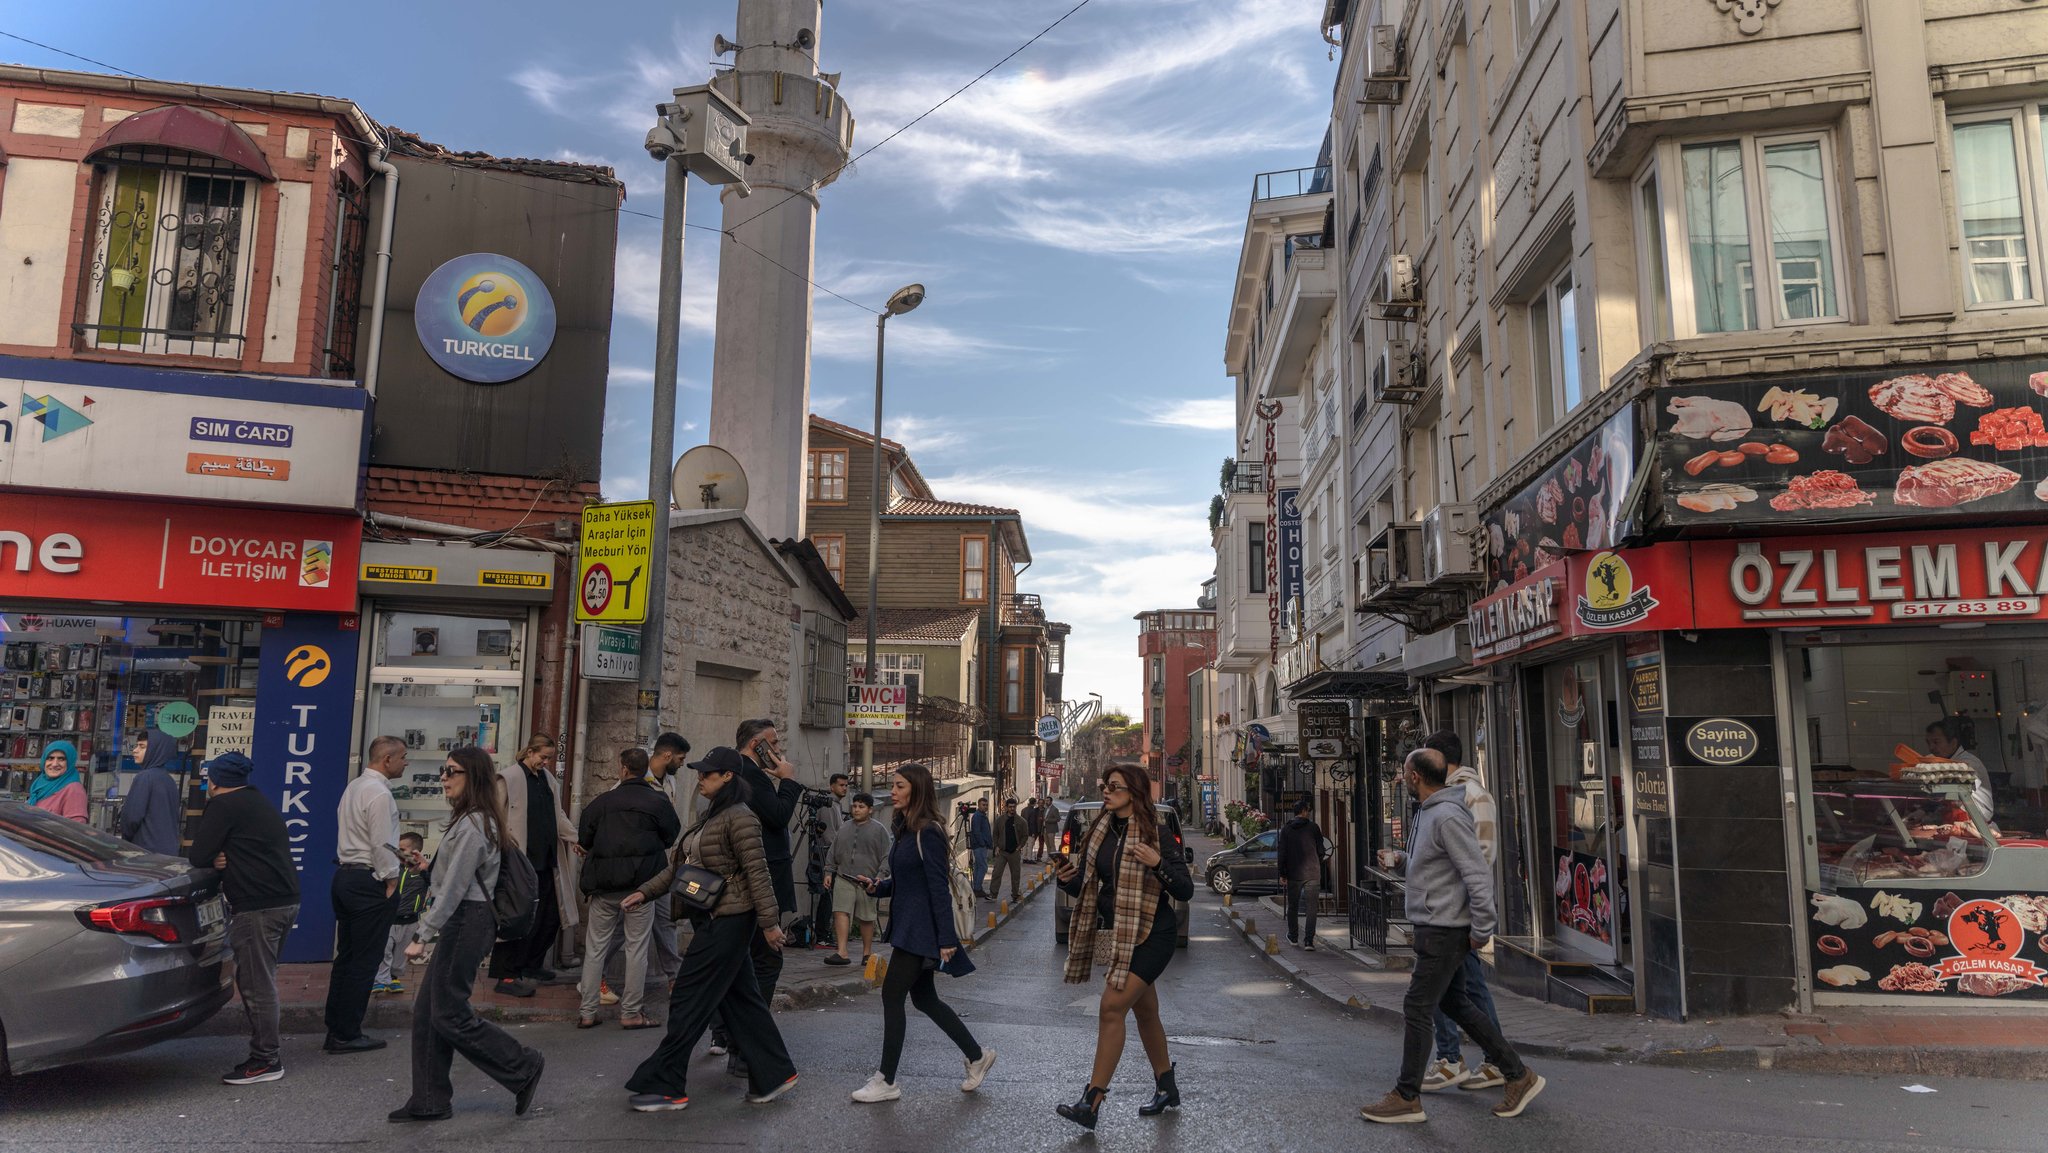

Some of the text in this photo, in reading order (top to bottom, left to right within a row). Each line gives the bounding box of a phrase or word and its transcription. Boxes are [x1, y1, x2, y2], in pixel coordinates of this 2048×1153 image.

[443, 338, 534, 361] TURKCELL
[195, 421, 289, 443] SIM CARD
[201, 457, 276, 476] بطاقة سيم
[587, 508, 651, 523] Daha Yüksek
[588, 524, 646, 541] Araçlar İçin
[189, 535, 297, 560] DOYCAR
[585, 544, 647, 558] Mecburi Yön
[1263, 422, 1279, 665] KUMLUK KONAK HOTEL
[1289, 529, 1300, 595] HOTE
[201, 558, 287, 583] İLETİŞİM
[368, 567, 405, 575] WESTERN
[485, 572, 520, 580] WESTERN
[1730, 540, 2048, 606] ÖZLEM K
[1586, 606, 1637, 622] ÖZLEM KASAP
[1903, 600, 2028, 616] 517 83 89
[45, 618, 96, 629] HUAWEI
[344, 618, 355, 627] 42
[600, 630, 641, 651] Avrasya Tun
[861, 687, 892, 705] WC
[852, 704, 897, 713] TOILET
[1300, 705, 1347, 714] HARBOUR
[171, 713, 196, 726] Kliq
[221, 723, 242, 731] SIM
[1307, 717, 1341, 726] SUITES
[1302, 728, 1347, 737] OLD CITY
[1696, 727, 1748, 743] Sayina
[1703, 745, 1743, 758] Hotel
[1635, 771, 1667, 795] Gloria
[1652, 799, 1667, 813] Hotel
[281, 704, 317, 930] TURKCE
[1952, 958, 2025, 975] ÖZLEM KASAP
